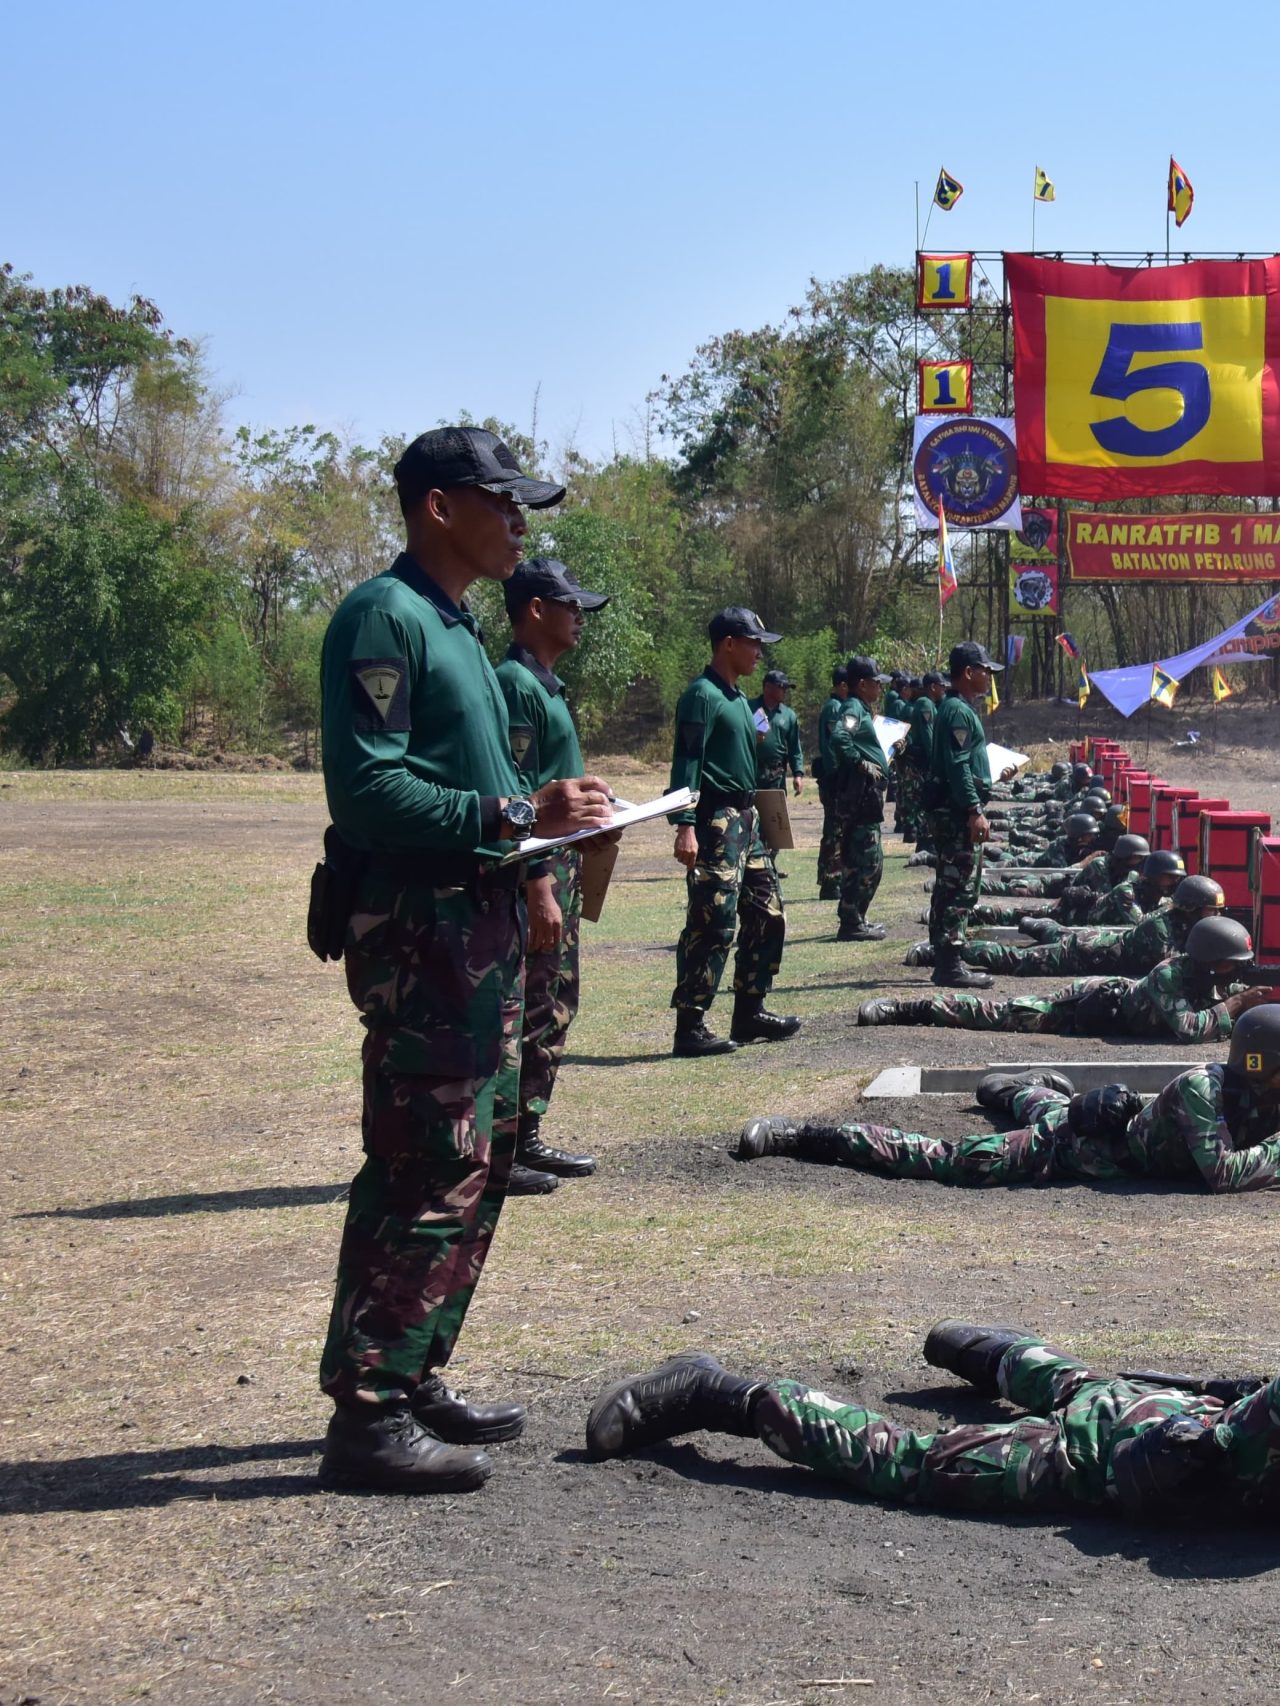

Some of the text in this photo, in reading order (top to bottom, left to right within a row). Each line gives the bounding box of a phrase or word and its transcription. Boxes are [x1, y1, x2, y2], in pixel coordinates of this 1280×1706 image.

[932, 263, 955, 299] 1
[933, 369, 956, 405] 1
[1089, 322, 1211, 457] 5
[1076, 522, 1220, 545] RANRATFIB
[1231, 523, 1242, 544] 1
[1111, 551, 1275, 570] BATALYON PETARUNG
[1248, 1055, 1259, 1069] 3
